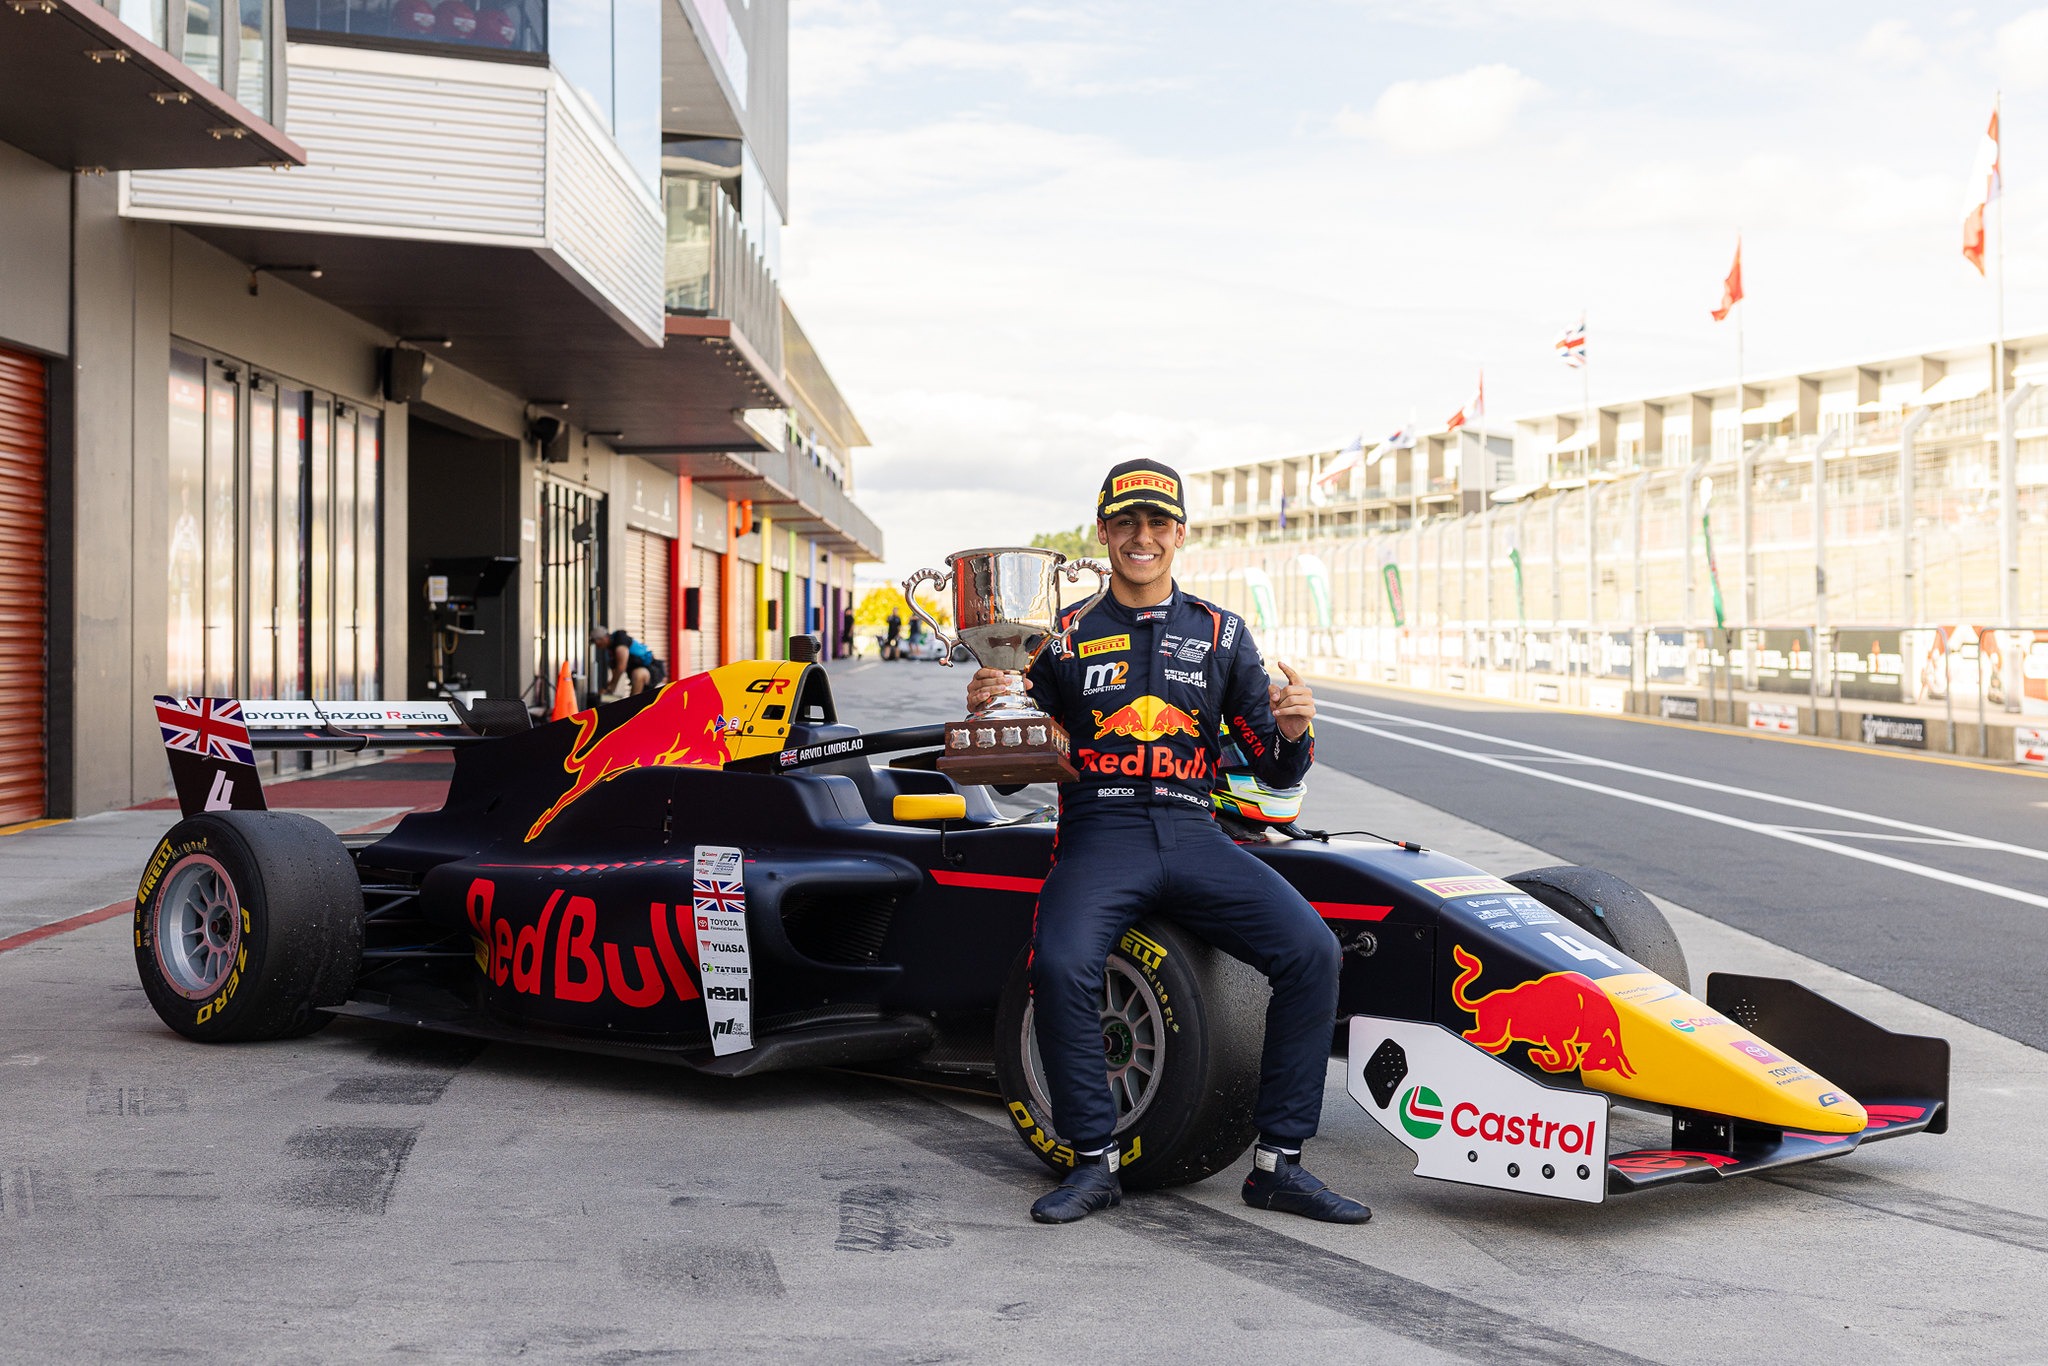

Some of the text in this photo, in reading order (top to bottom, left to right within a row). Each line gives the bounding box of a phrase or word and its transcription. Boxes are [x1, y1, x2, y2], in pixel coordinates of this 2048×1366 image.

[1116, 474, 1175, 493] PIRELLI
[1221, 616, 1238, 650] sparco
[1083, 638, 1125, 654] PIRELLI
[746, 679, 790, 695] GR
[1083, 684, 1126, 696] COMPETITION
[246, 711, 449, 722] OYOTA GAZOO Racing
[730, 719, 738, 731] E
[799, 738, 864, 761] ARVID LINDBLAD
[1078, 744, 1207, 780] Red Bull
[204, 769, 234, 812] 4
[1097, 787, 1135, 797] sparco
[138, 838, 173, 904] PIRELLI
[710, 918, 739, 927] TOYOTA
[466, 877, 701, 1008] Red Bull
[711, 943, 745, 953] YUASA
[1540, 931, 1624, 969] 4
[196, 941, 248, 1025] ZERO
[706, 986, 748, 1002] real
[1450, 1102, 1596, 1156] Castrol
